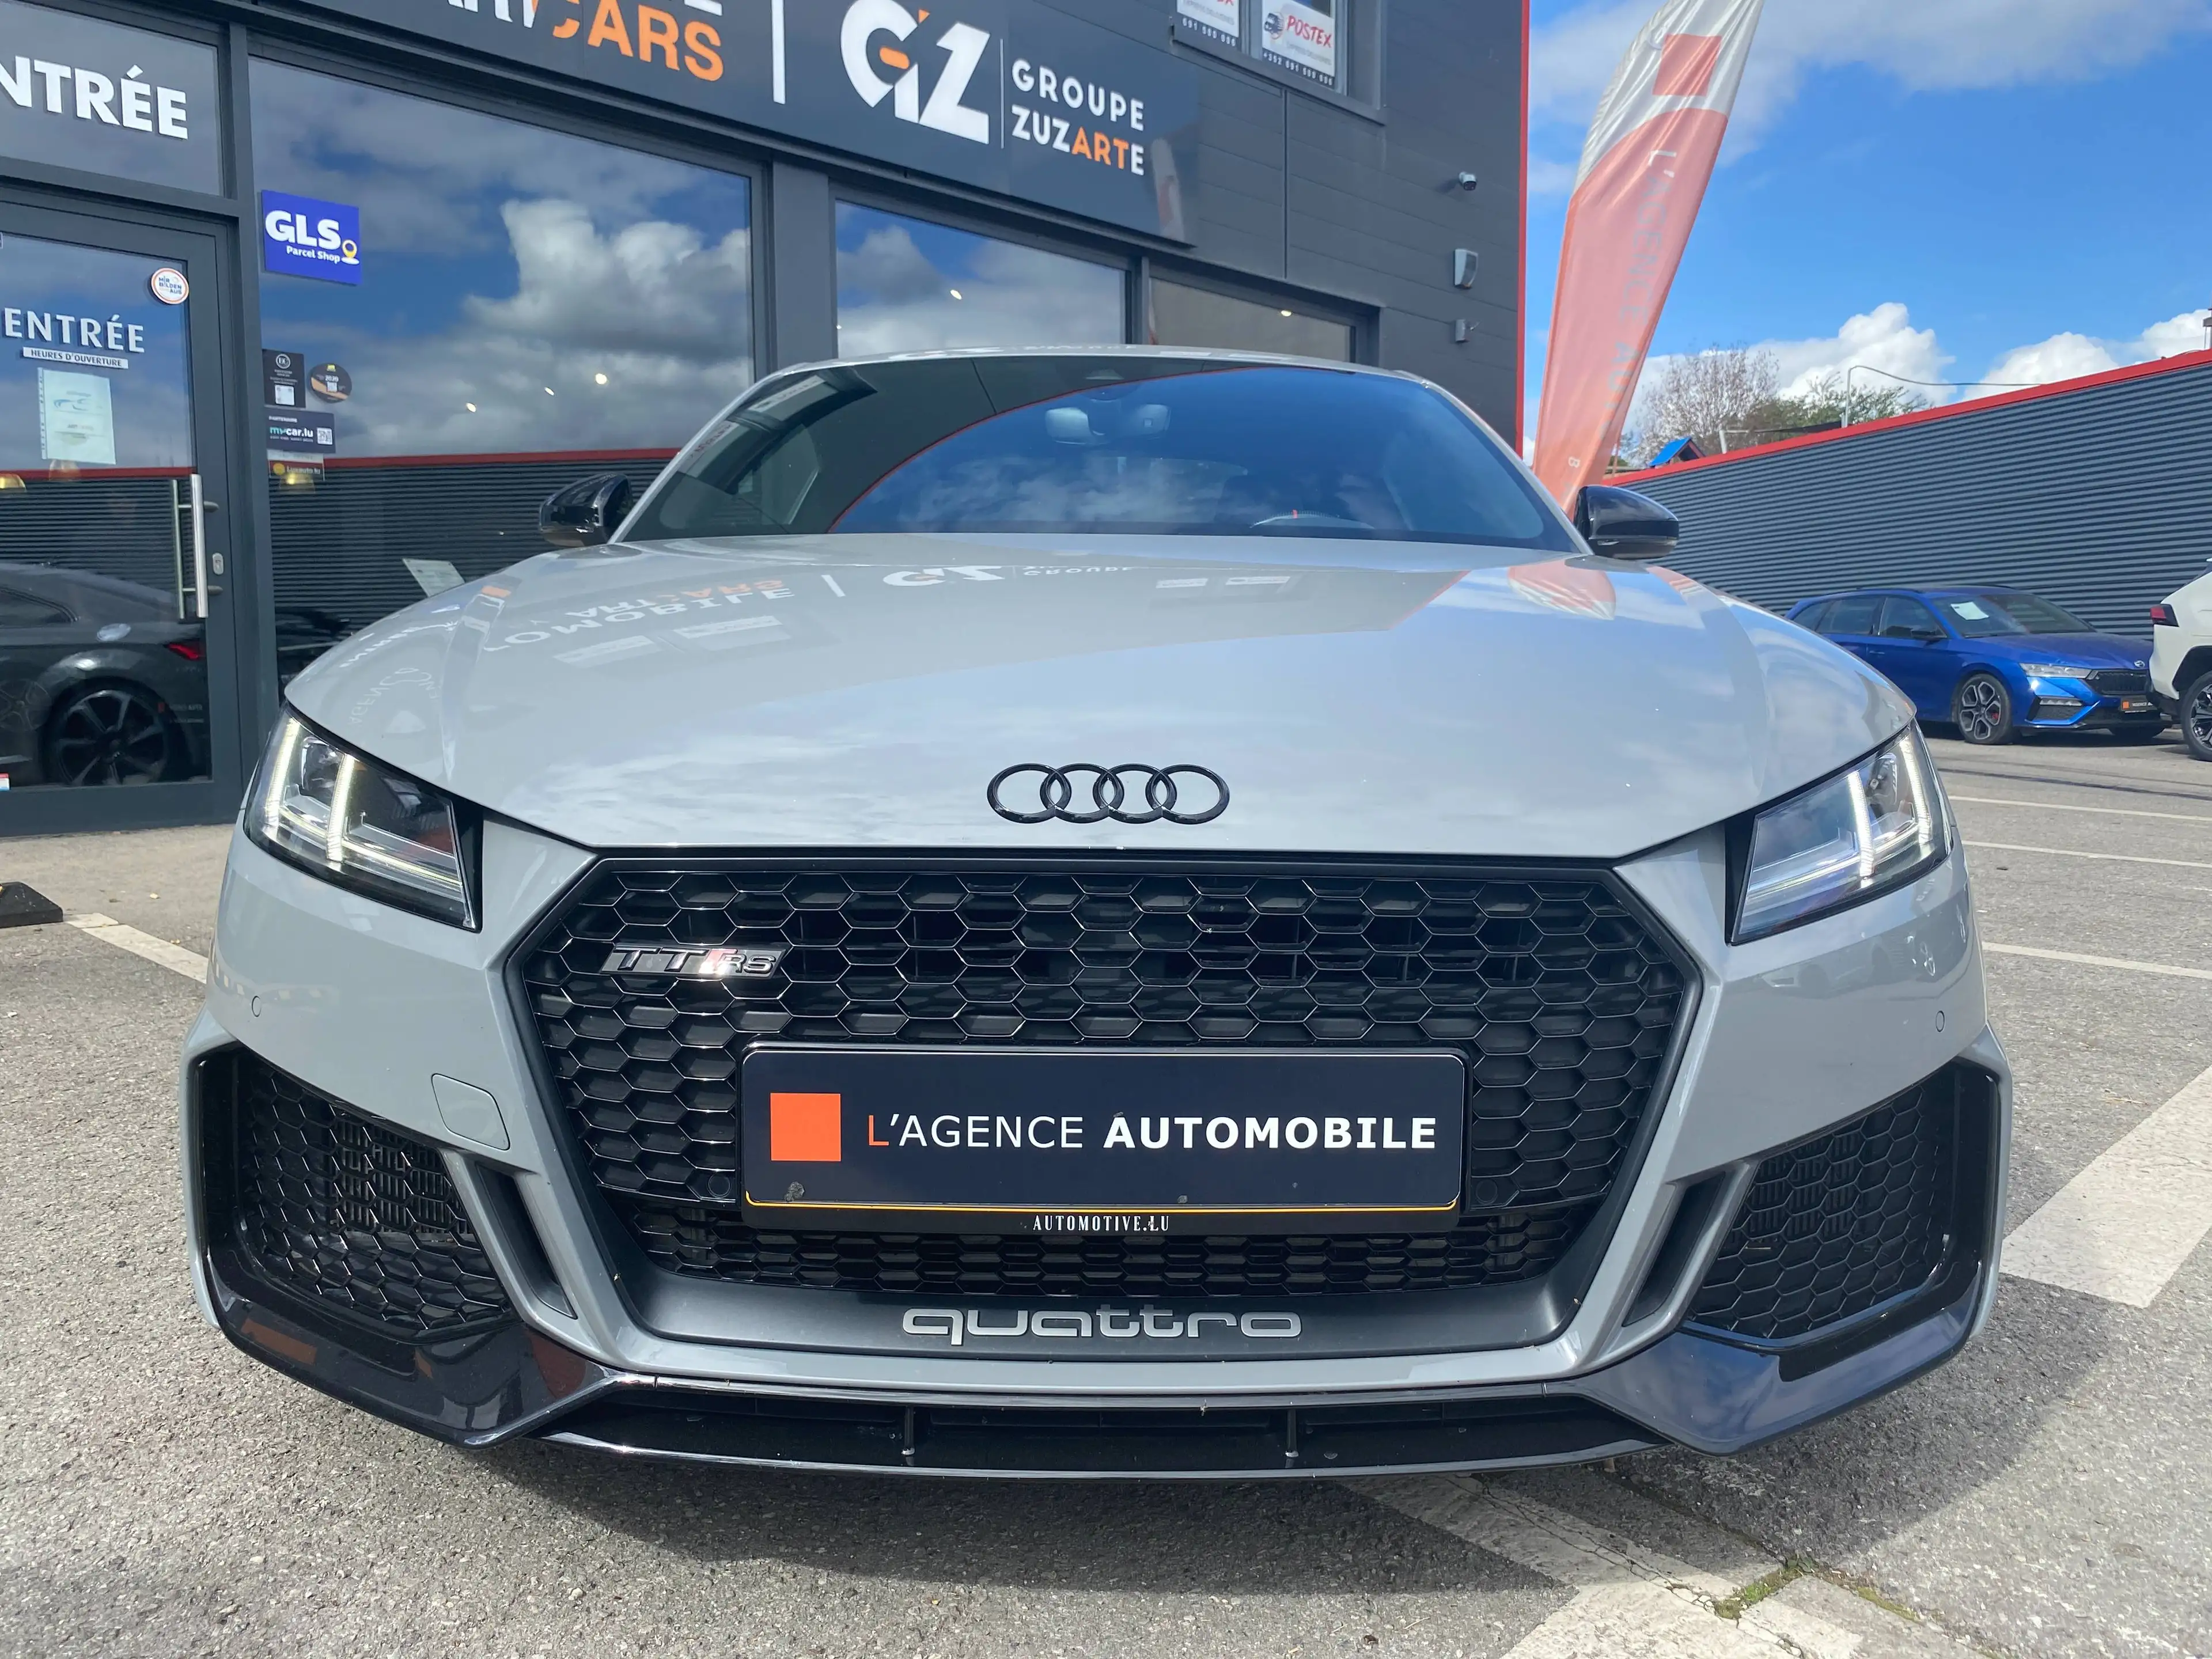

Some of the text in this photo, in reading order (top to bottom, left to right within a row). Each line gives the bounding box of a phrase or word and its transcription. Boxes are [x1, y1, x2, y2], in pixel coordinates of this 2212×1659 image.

[1287, 15, 1332, 48] POSTEX
[1012, 59, 1144, 131] GROUPE
[1012, 105, 1144, 176] ZUZARTE
[265, 210, 342, 250] GLS
[1619, 149, 1677, 325] L'AGENCE
[286, 245, 340, 264] Parcel Shop
[4, 307, 145, 353] ENTRÉE
[31, 349, 122, 366] HEURES D'OUVERTURE
[270, 427, 313, 437] mycar.lu
[868, 1114, 1437, 1149] L'AGENCE AUTOMOBILE
[1033, 1215, 1171, 1232] AUTOMOTIVE.LU
[902, 1304, 1302, 1346] quattro
